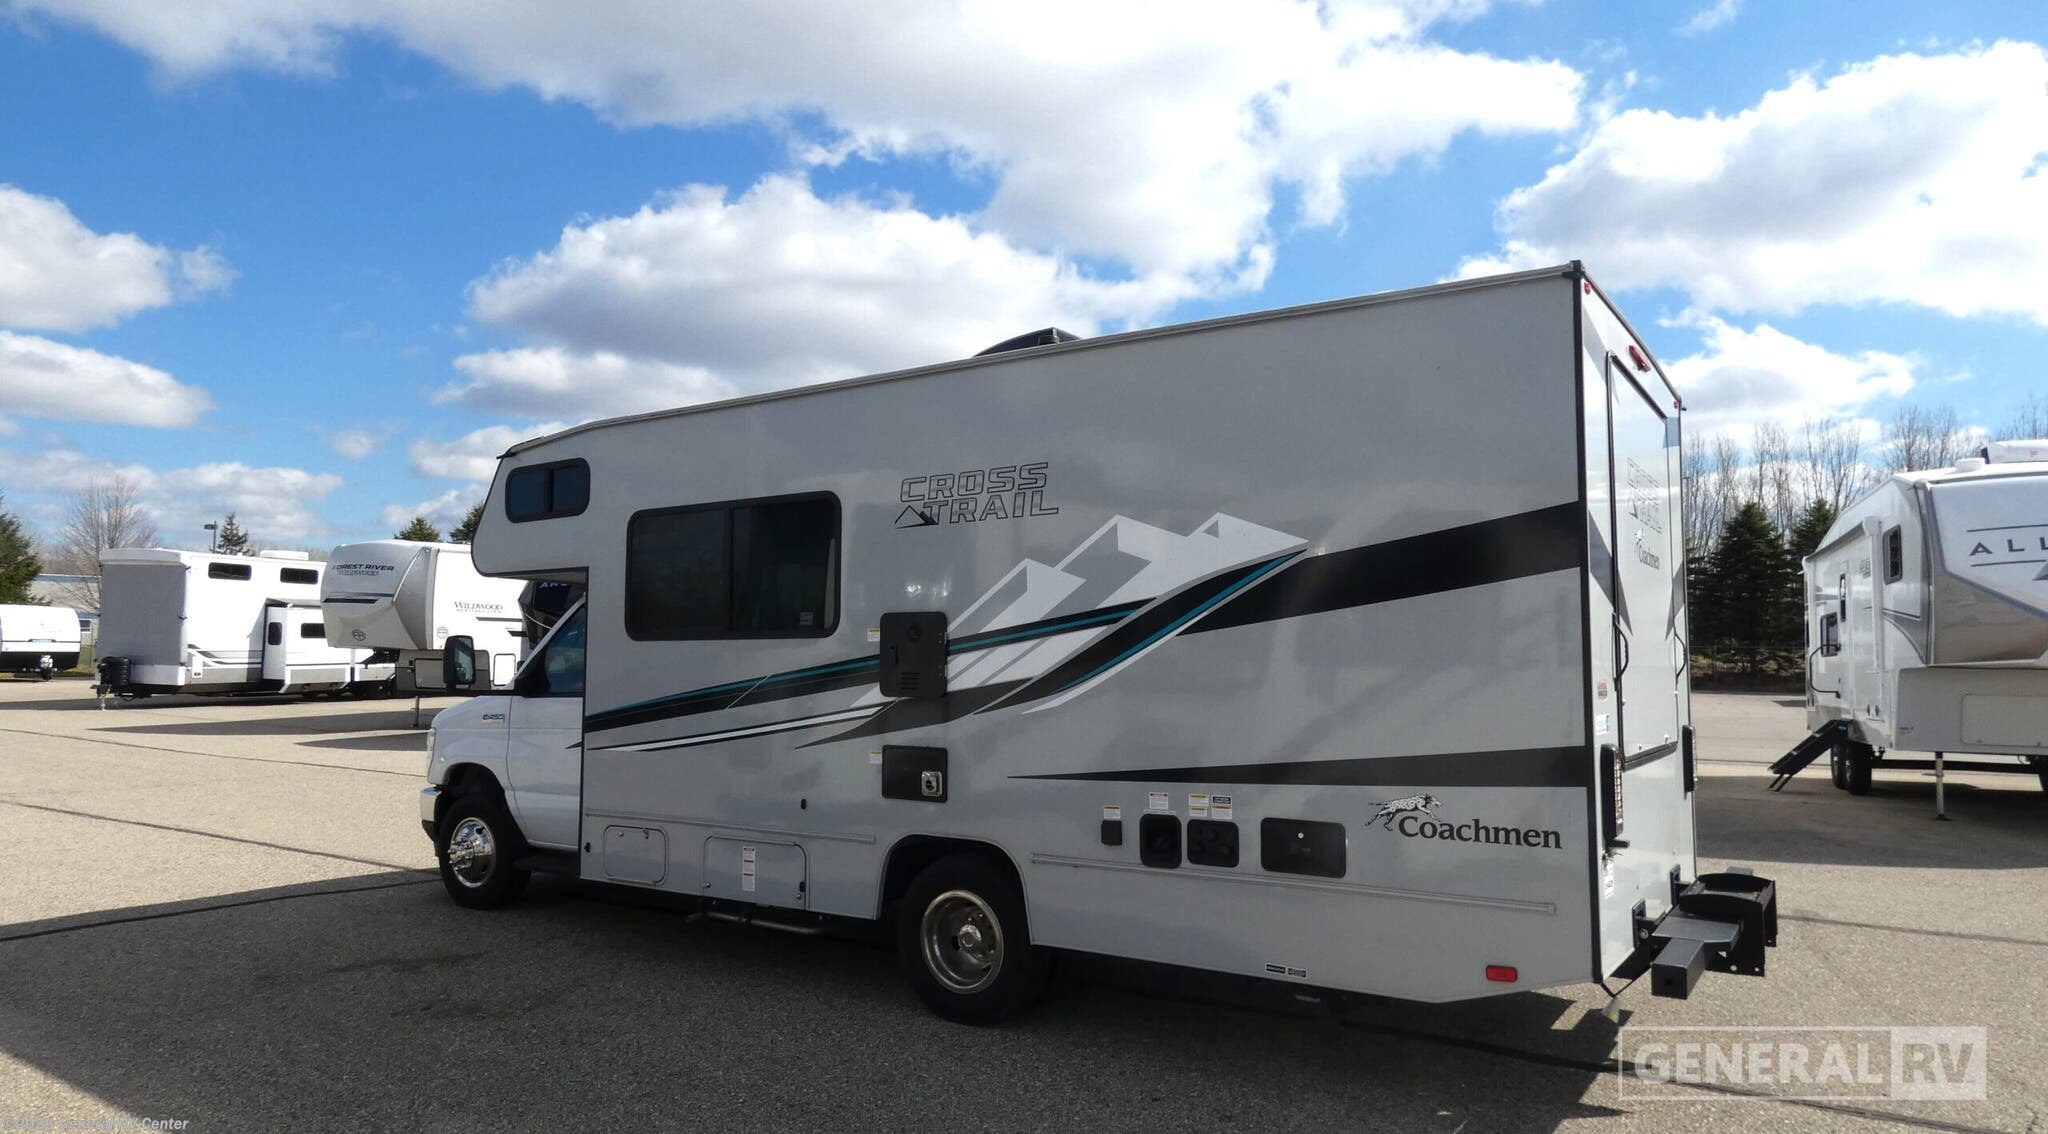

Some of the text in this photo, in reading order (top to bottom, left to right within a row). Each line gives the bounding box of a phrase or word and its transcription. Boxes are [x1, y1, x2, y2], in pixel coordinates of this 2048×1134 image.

[901, 462, 1048, 502] CROSS
[923, 490, 1059, 524] TRAIL
[1399, 816, 1563, 849] Coachmen
